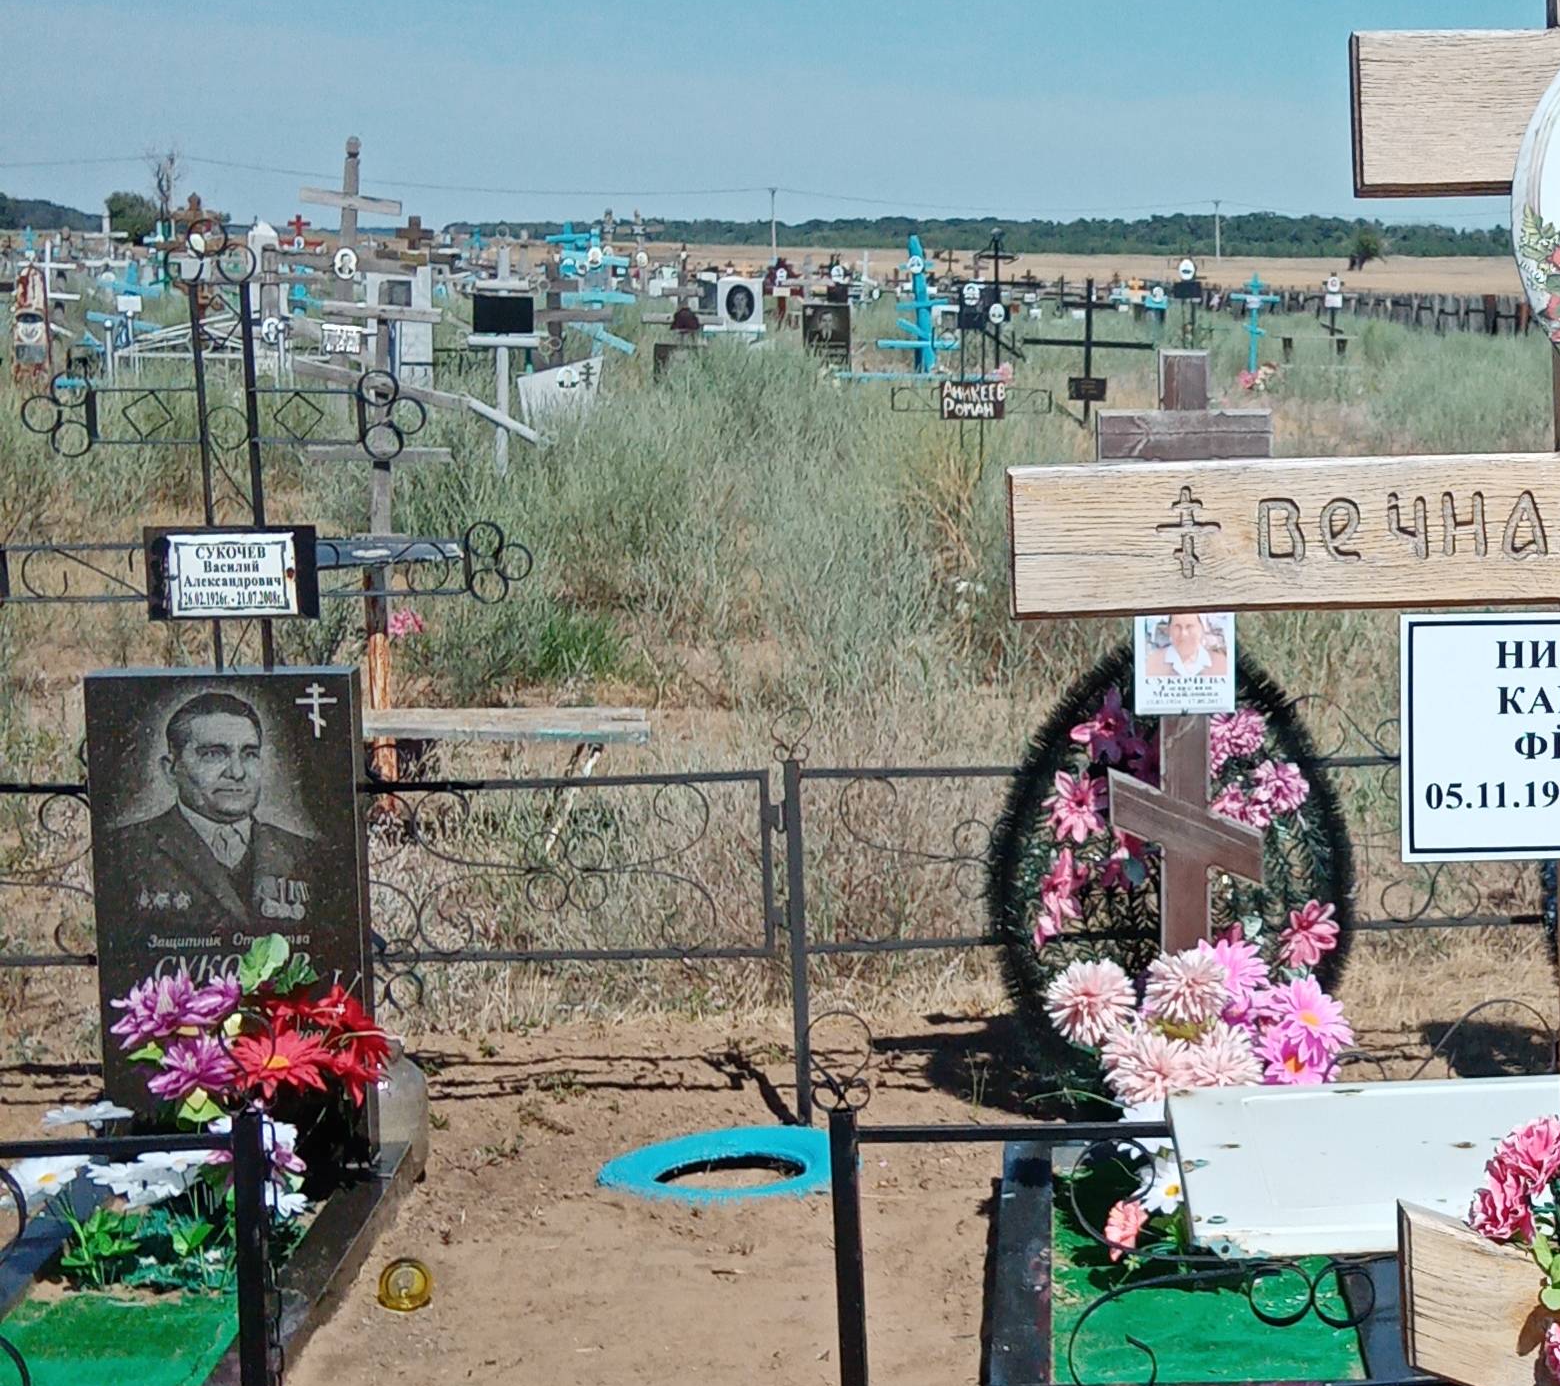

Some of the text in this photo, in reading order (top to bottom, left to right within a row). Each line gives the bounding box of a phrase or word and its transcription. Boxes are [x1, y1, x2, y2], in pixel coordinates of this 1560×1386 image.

[195, 545, 266, 559] СУКОЧЕВ
[203, 560, 260, 574] Василий
[183, 574, 282, 590] Александрович
[147, 933, 222, 950] Защитник
